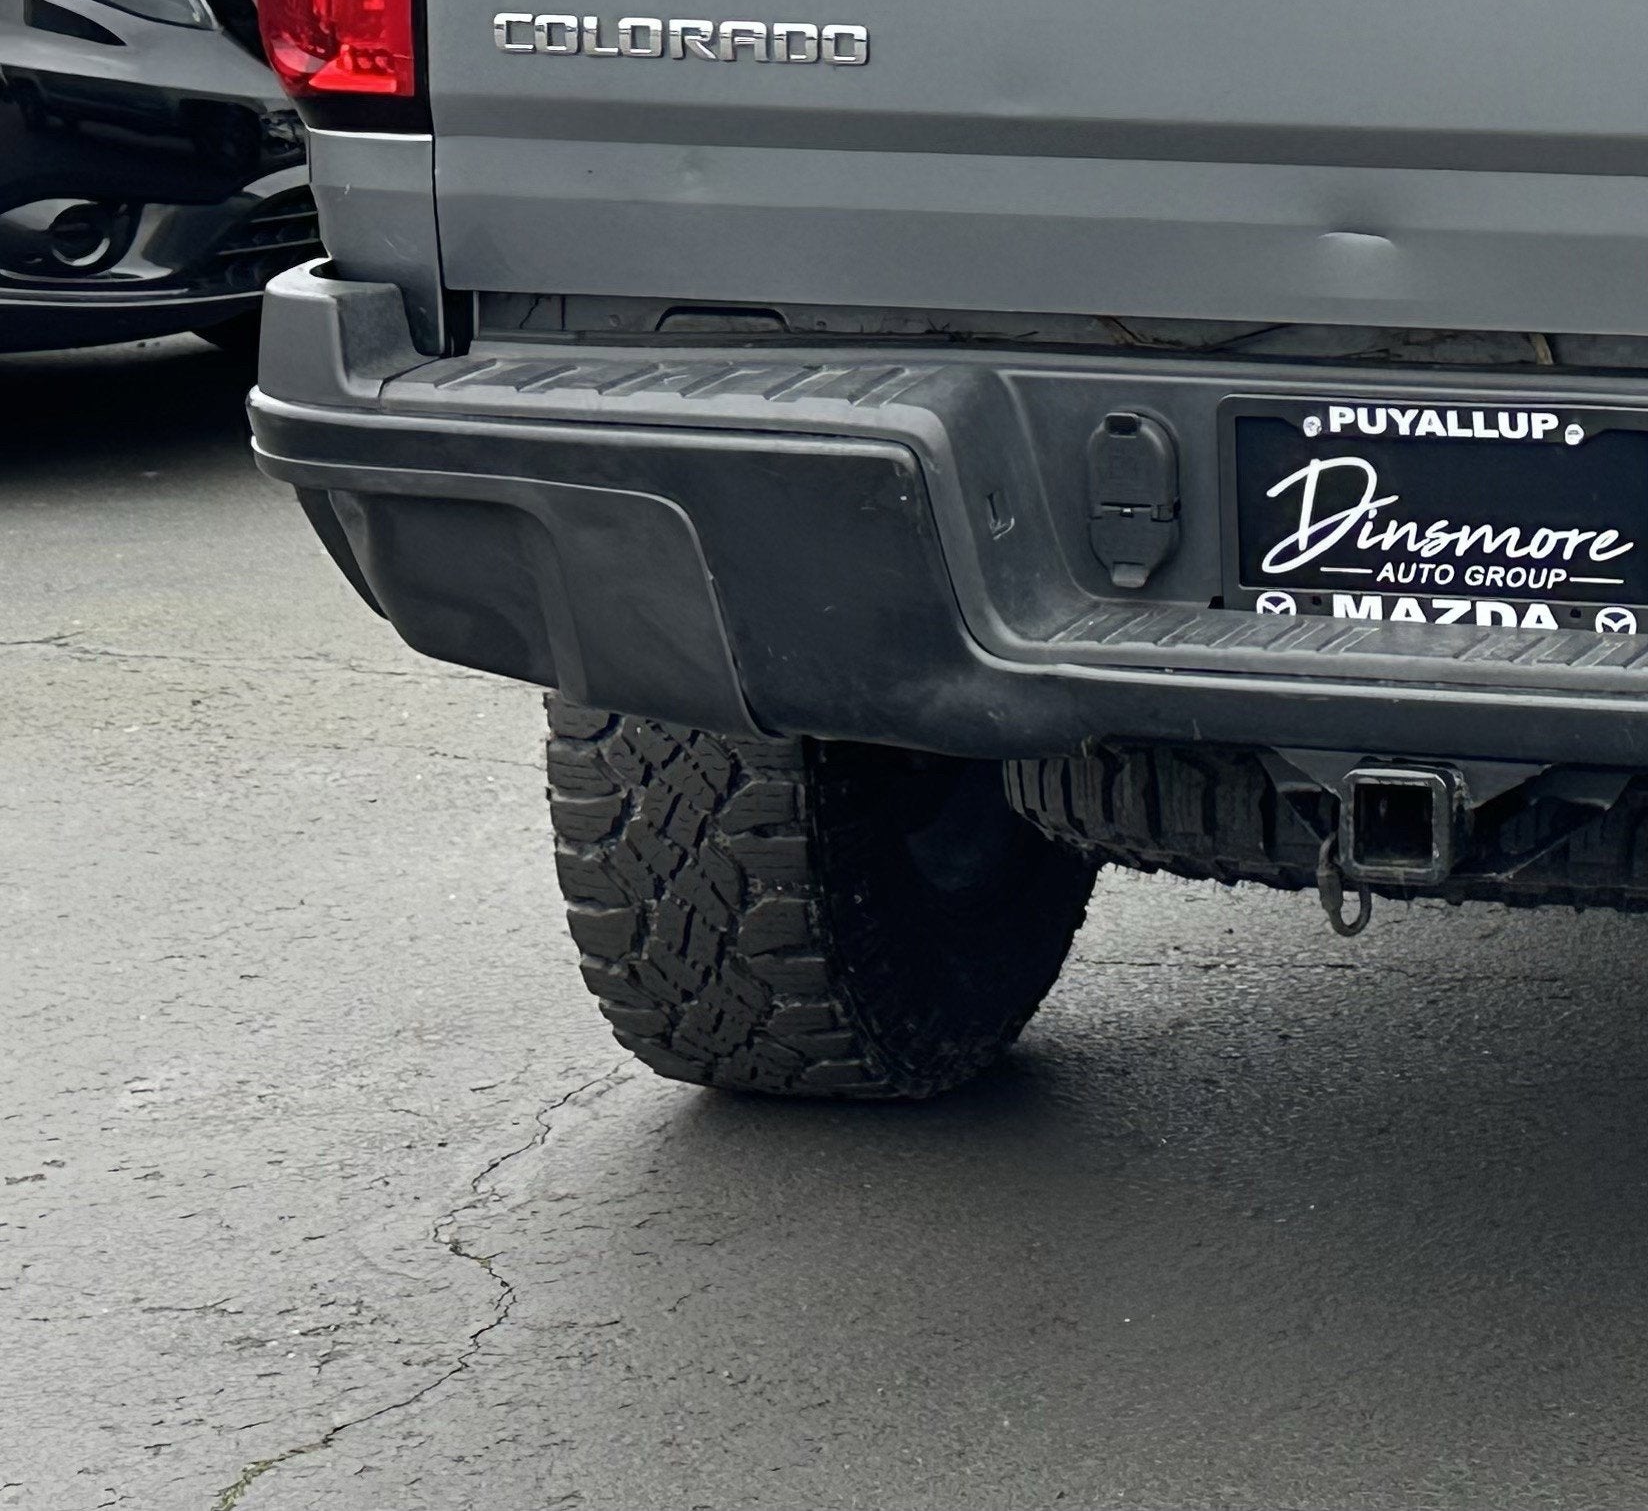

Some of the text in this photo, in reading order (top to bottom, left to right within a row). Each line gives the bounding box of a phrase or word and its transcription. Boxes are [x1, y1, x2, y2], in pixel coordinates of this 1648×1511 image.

[493, 12, 870, 65] COLORADO
[1328, 406, 1559, 439] PUYALLUP
[1262, 456, 1634, 574] Dinsmore
[1376, 563, 1568, 589] AUTO GROUP
[1332, 594, 1559, 630] MAZDA
